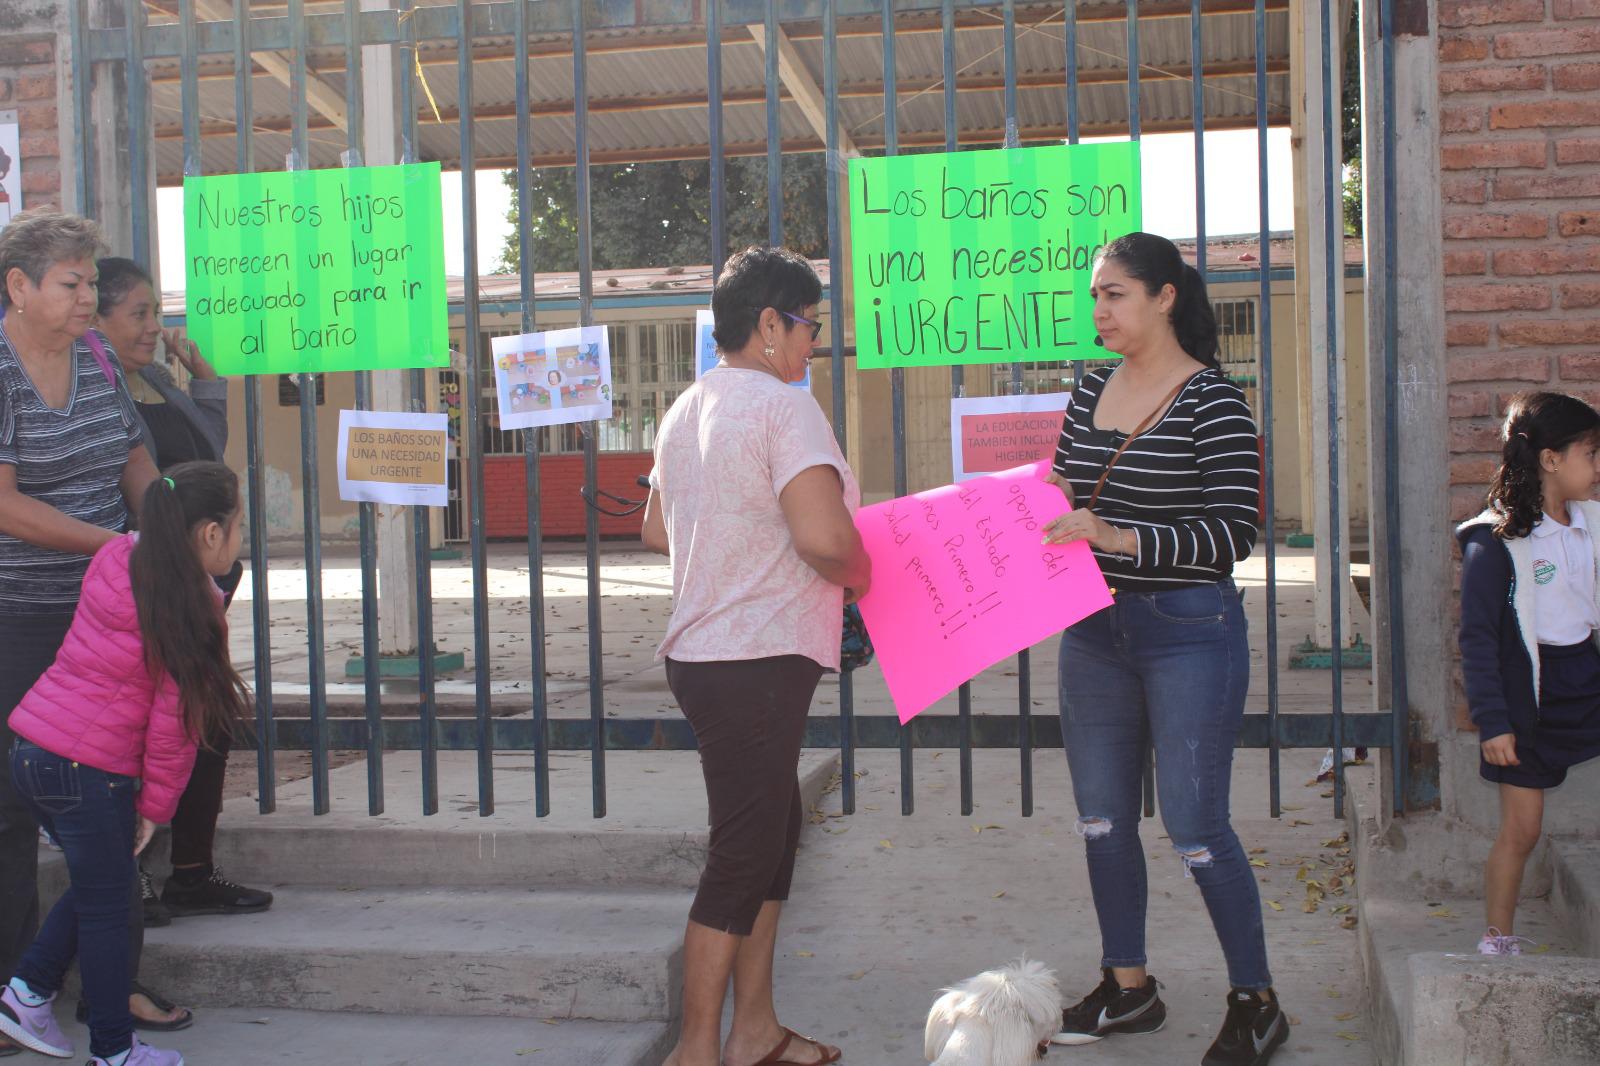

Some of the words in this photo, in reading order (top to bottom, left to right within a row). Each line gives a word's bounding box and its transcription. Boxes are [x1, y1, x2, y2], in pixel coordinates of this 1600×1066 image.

[198, 189, 323, 229] Nuestros
[340, 183, 404, 234] hijos
[861, 167, 927, 217] Los
[941, 166, 1049, 220] baños
[1066, 183, 1127, 217] son
[193, 252, 289, 277] merecen
[308, 251, 334, 269] un
[351, 240, 413, 276] lugar
[868, 250, 926, 288] una
[196, 281, 306, 316] adecuado
[333, 284, 387, 316] para
[402, 279, 422, 300] ir
[240, 319, 265, 355] al
[290, 317, 357, 351] baño
[872, 290, 1104, 356] ¡URGENTE
[354, 432, 375, 444] LOS
[378, 432, 415, 446] BAÑOS
[417, 435, 441, 447] SON
[968, 436, 1017, 449] TAMBIEN
[1020, 434, 1061, 447] INCLUY
[976, 423, 989, 433] LA
[992, 419, 1057, 432] EDUCACION
[352, 448, 378, 460] UNA
[381, 449, 441, 463] NECESIDAD
[370, 464, 423, 478] URGENTE
[995, 449, 1041, 463] HIGIENE
[976, 515, 1010, 578] Estado
[1007, 484, 1038, 531] apoyo
[1041, 552, 1069, 580] del
